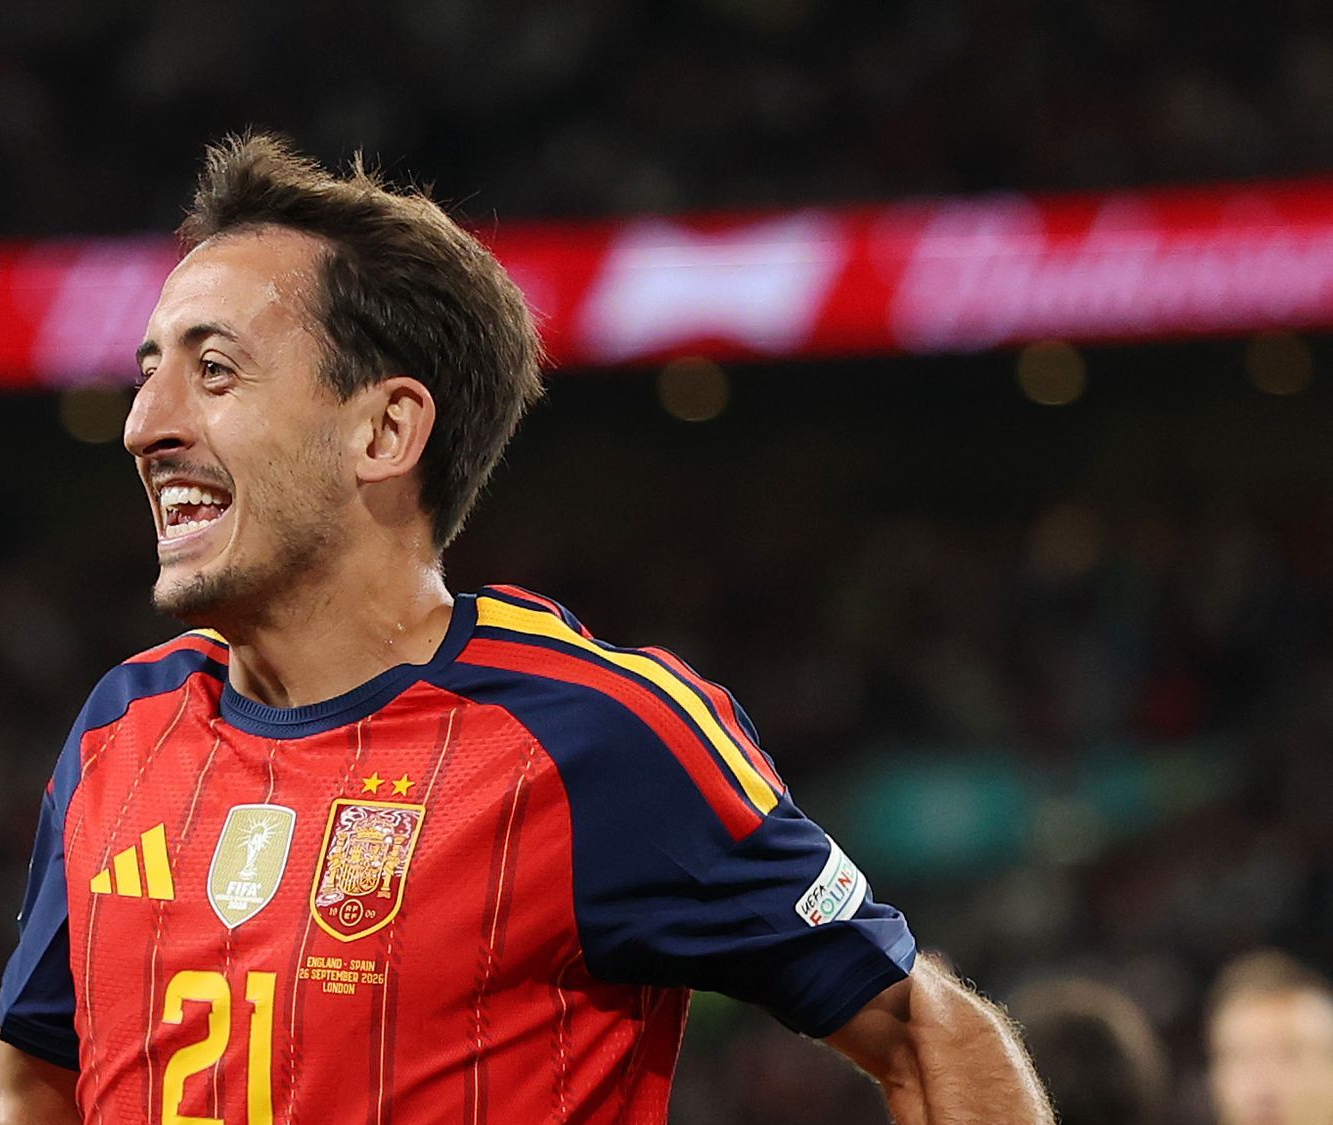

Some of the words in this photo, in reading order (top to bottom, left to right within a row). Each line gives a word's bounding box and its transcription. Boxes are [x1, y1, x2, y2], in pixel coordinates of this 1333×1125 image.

[226, 881, 258, 897] FIFA
[801, 884, 827, 915] UEFA
[306, 956, 343, 969] ENGLAND
[349, 959, 375, 972] SPAIN
[298, 968, 310, 979] 26
[311, 968, 359, 983] SEPTEMBER
[360, 972, 385, 985] 2026
[322, 981, 356, 995] LONDON
